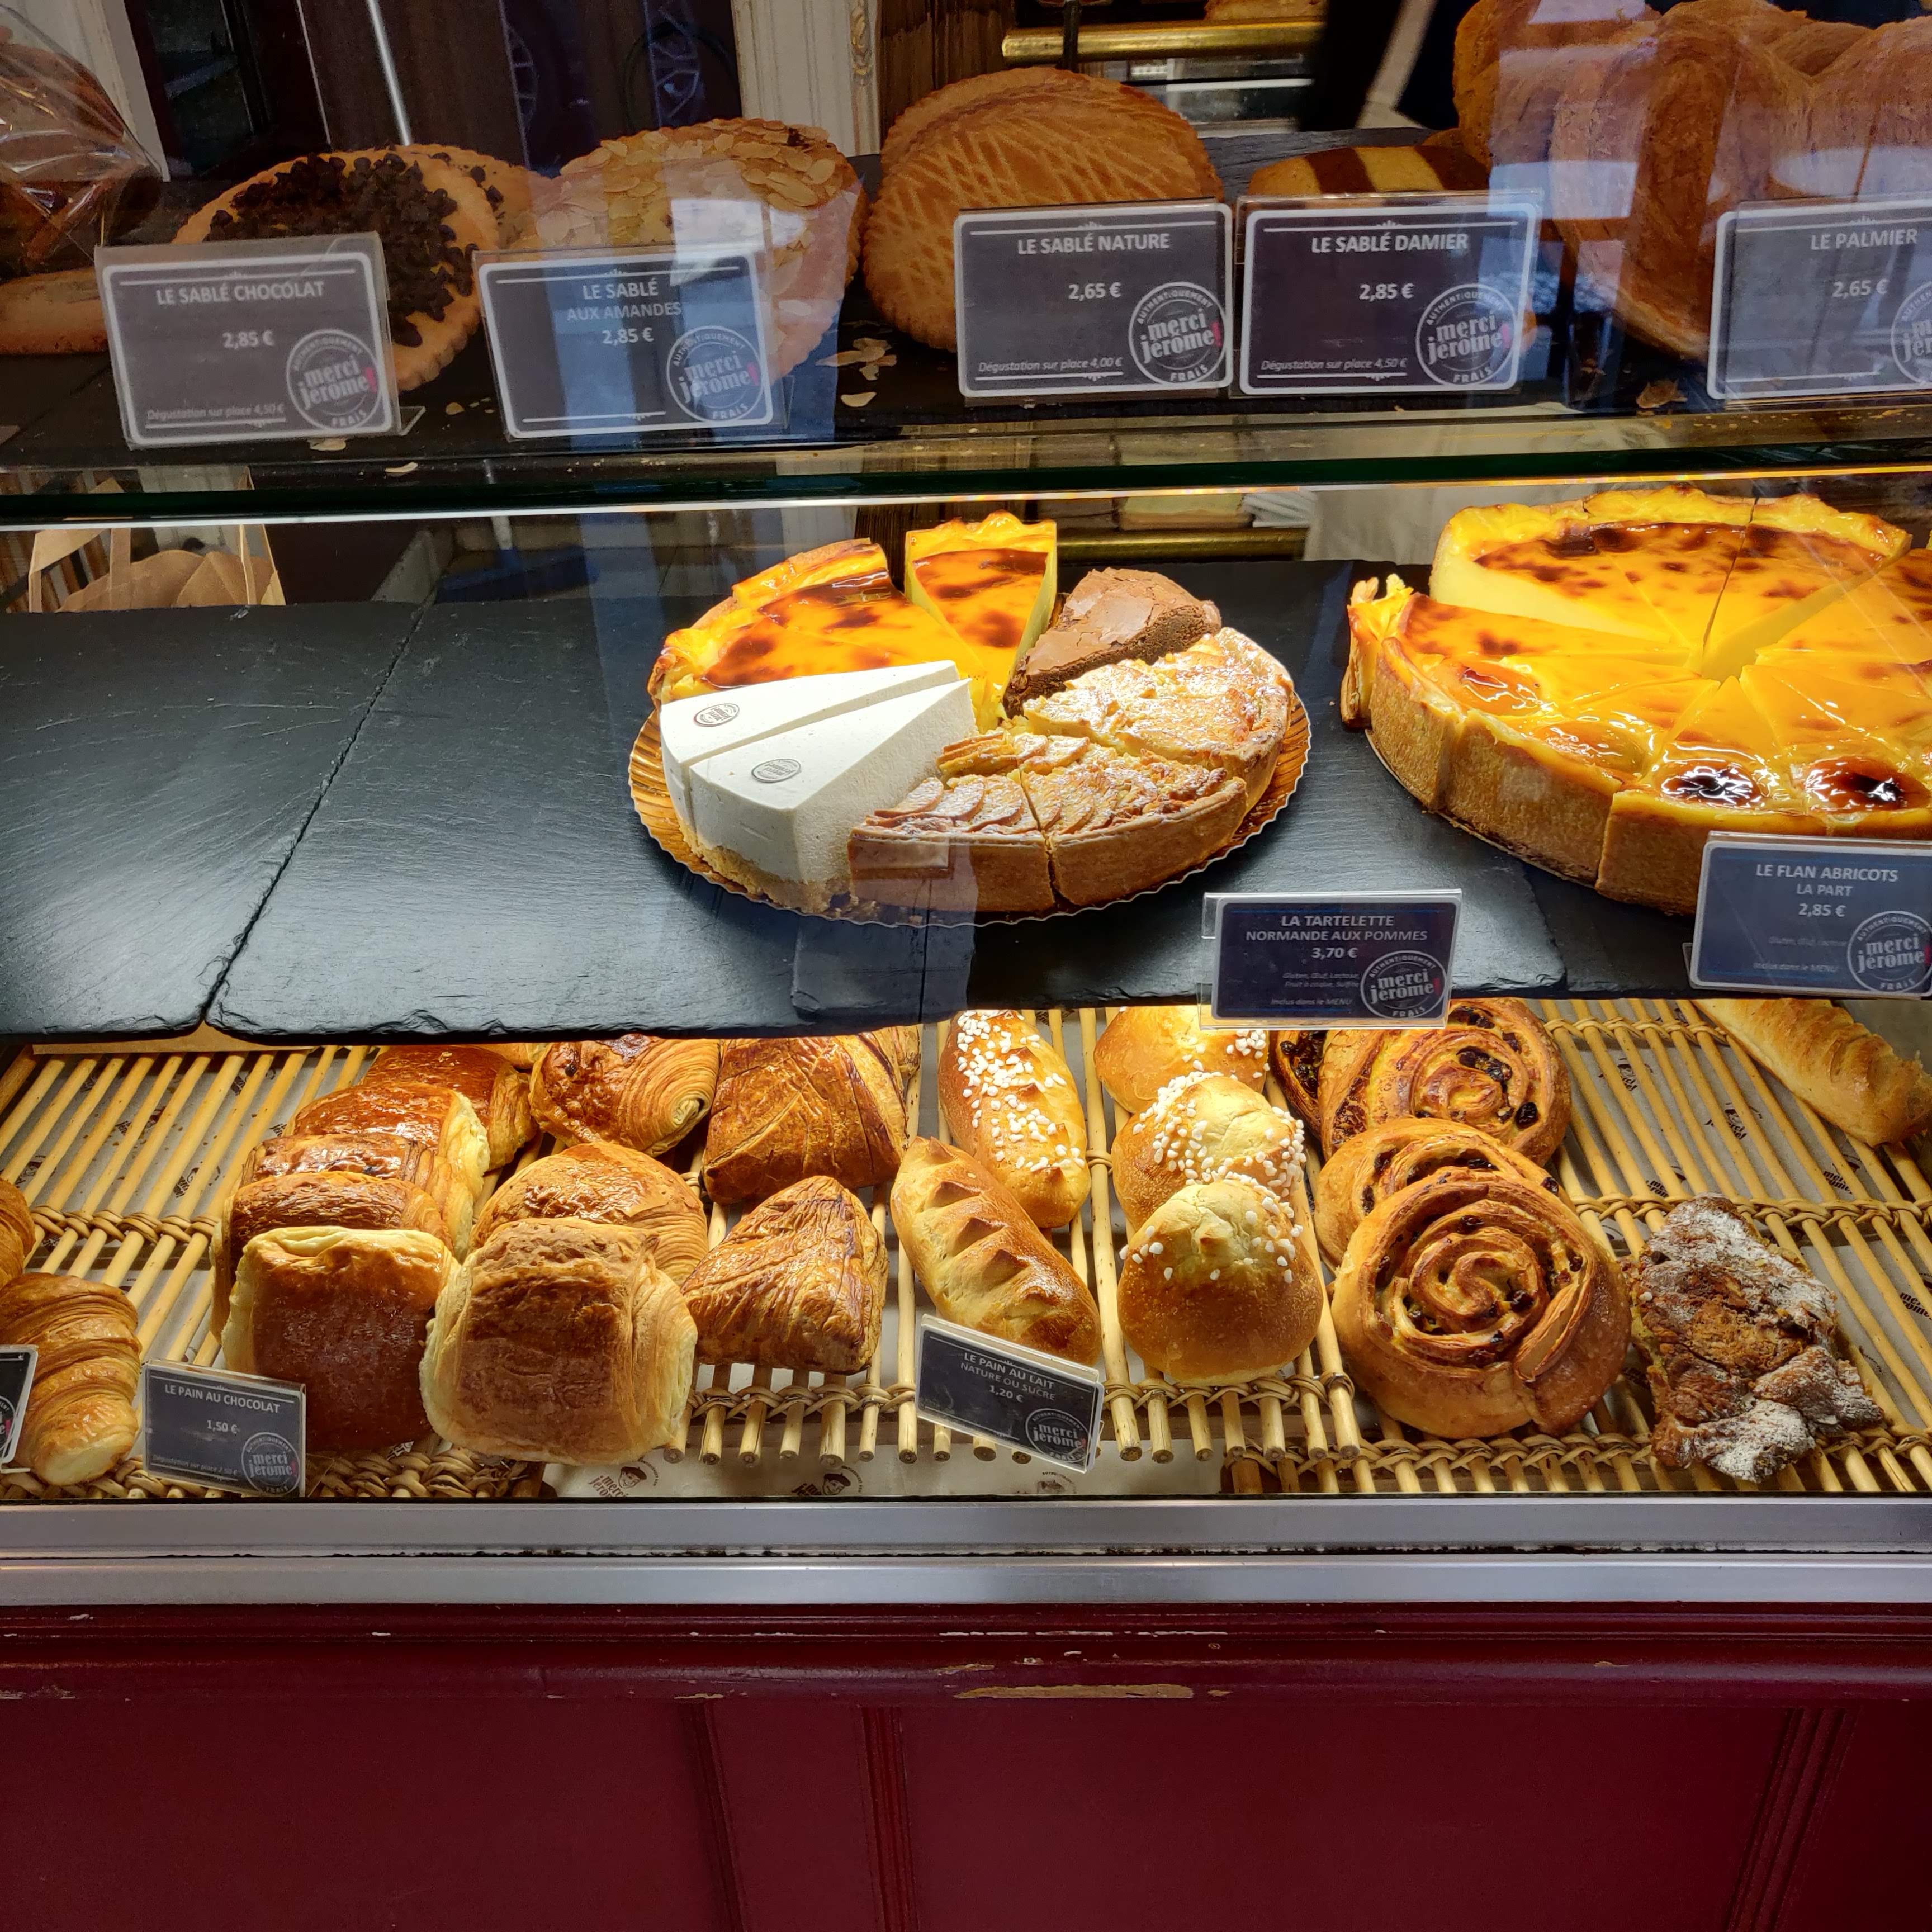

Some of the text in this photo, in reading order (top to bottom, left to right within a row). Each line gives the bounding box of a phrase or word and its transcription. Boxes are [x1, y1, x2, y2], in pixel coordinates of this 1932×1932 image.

[1018, 232, 1169, 255] LE SABLÉ NATURE
[1311, 233, 1469, 253] LE SABLÉ DAMIER
[1811, 228, 1917, 250] LE PALMIER
[156, 281, 325, 305] LE SABLÉ CHOCOLAT
[583, 278, 659, 300] LE SABLÉ
[1068, 282, 1121, 301] 2,65 €
[1359, 283, 1415, 302] 2,85 €
[1832, 279, 1889, 299] 2,65 €
[566, 302, 683, 322] AUX AMANDES
[1148, 308, 1207, 341] merci
[1436, 310, 1496, 342] merci
[222, 330, 274, 349] 2,85 €
[602, 326, 654, 346] 2,85 €
[304, 353, 360, 387] merci
[684, 350, 743, 383] merci
[979, 360, 1040, 373] Dégustation
[1043, 361, 1059, 370] sur
[1060, 358, 1088, 371] place
[1171, 364, 1208, 381] FRAIS
[1261, 359, 1324, 372] Dégustation
[1325, 361, 1342, 369] sur
[1344, 358, 1372, 371] place
[1453, 366, 1494, 383] FRAIS
[147, 407, 207, 420] Dégustation
[332, 409, 366, 428] FRAIS
[712, 402, 748, 419] FRAIS
[1756, 864, 1898, 882] LE FLAN ABRICOTS
[1796, 884, 1853, 896] LA PART
[1798, 903, 1846, 917] 2,85 €
[1281, 915, 1395, 926] LA TARTELETTE
[1246, 930, 1428, 941] NORMANDE AUX POMMES
[1866, 933, 1920, 954] merci
[1311, 947, 1358, 960] 3,70 €
[1378, 969, 1429, 989] merci
[1880, 978, 1915, 989] FRAIS
[1393, 1007, 1426, 1017] FRAIS
[964, 1353, 1055, 1389] LE PAIN AU LAIT
[960, 1362, 1056, 1401] NATURE OU SUCRE
[165, 1384, 280, 1413] LE PAIN AU CHOCOLAT
[989, 1385, 1024, 1402] 1,20 €
[207, 1420, 228, 1432] 1,50
[1038, 1423, 1078, 1438] merci
[253, 1451, 288, 1465] merci
